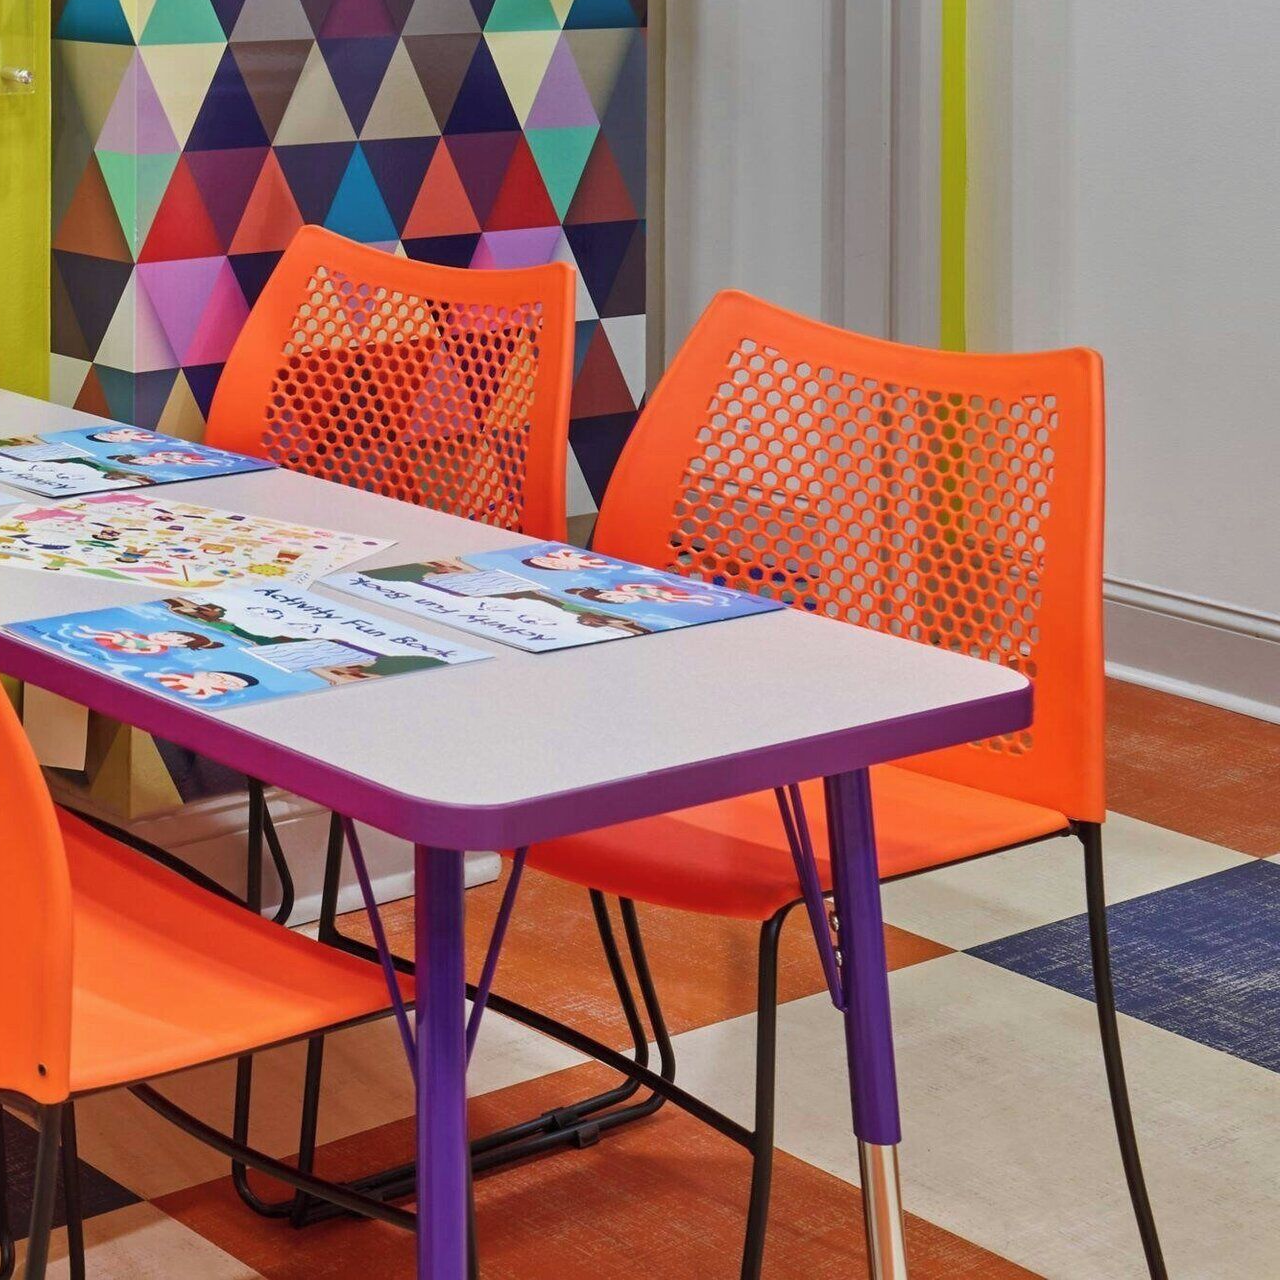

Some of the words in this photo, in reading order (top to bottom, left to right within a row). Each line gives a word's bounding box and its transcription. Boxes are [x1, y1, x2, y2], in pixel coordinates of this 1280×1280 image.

[349, 577, 411, 600] Book
[415, 598, 460, 614] Fun
[253, 588, 344, 619] Activity
[341, 620, 386, 637] Fun
[390, 635, 458, 658] Book
[458, 614, 557, 641] Activity
